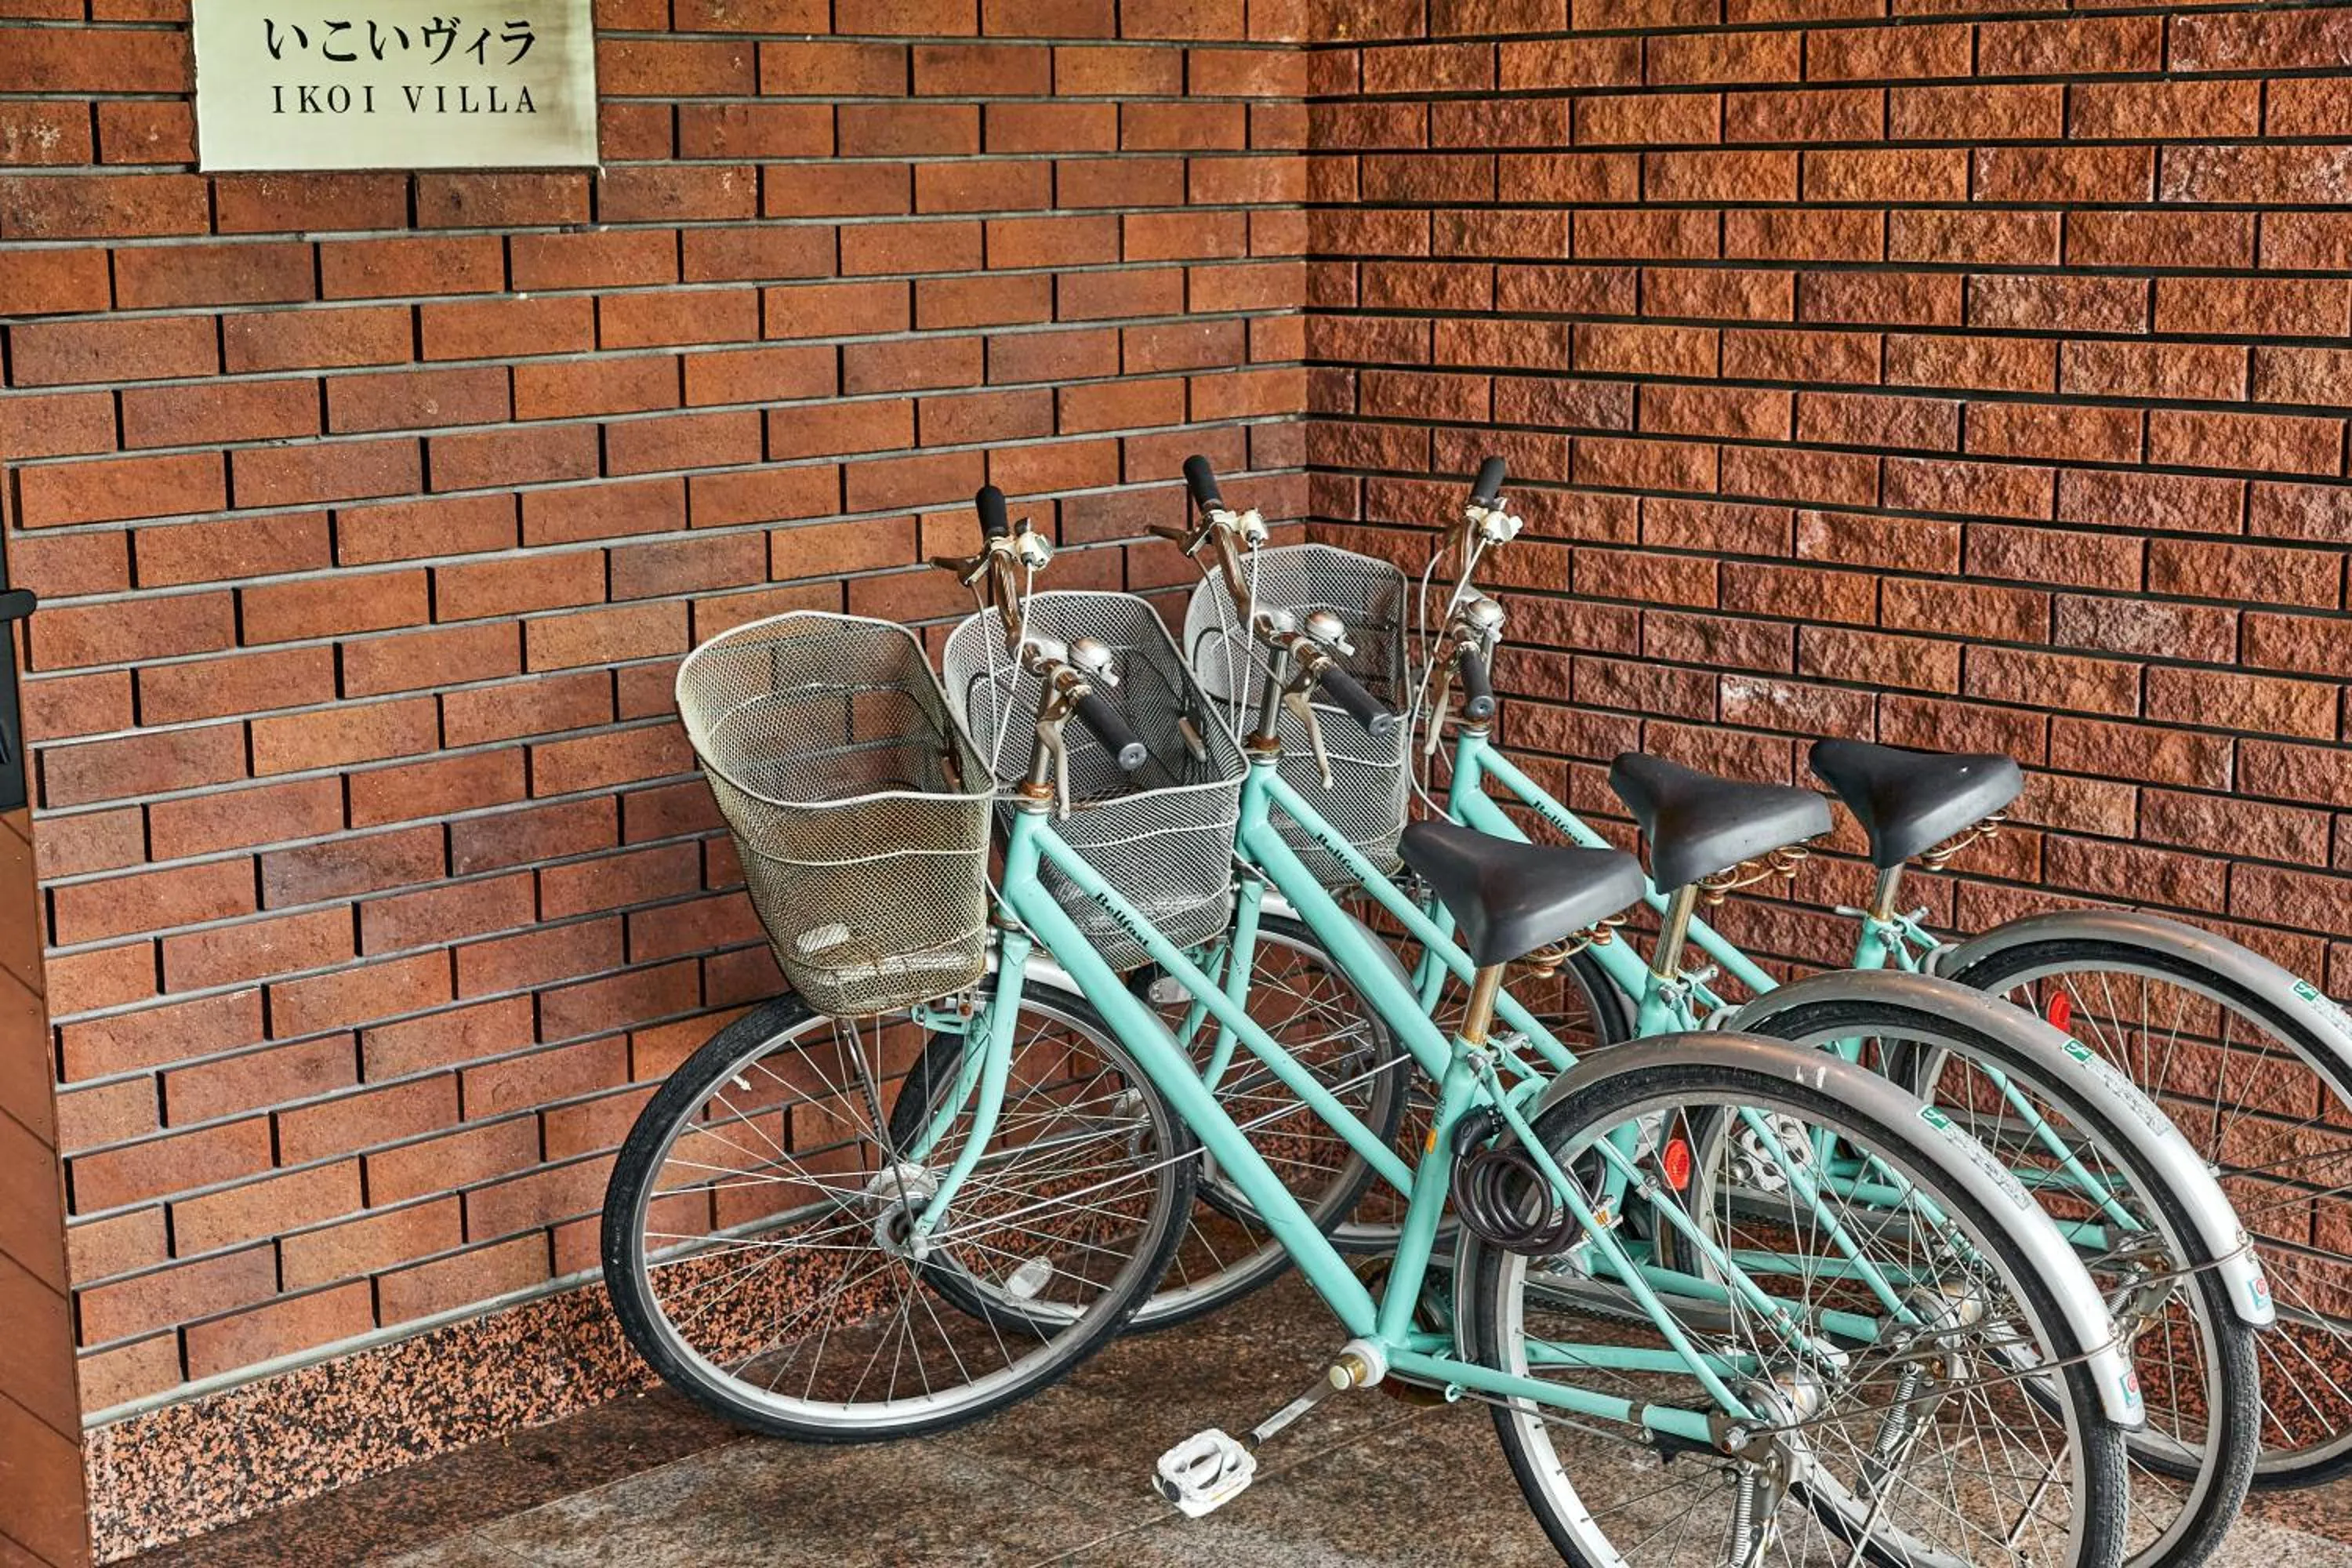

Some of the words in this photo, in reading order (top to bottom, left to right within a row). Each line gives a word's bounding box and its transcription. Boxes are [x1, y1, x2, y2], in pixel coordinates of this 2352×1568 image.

[263, 16, 536, 66] いこいヴィラ
[271, 85, 376, 114] IKOI
[402, 85, 538, 114] VILLA
